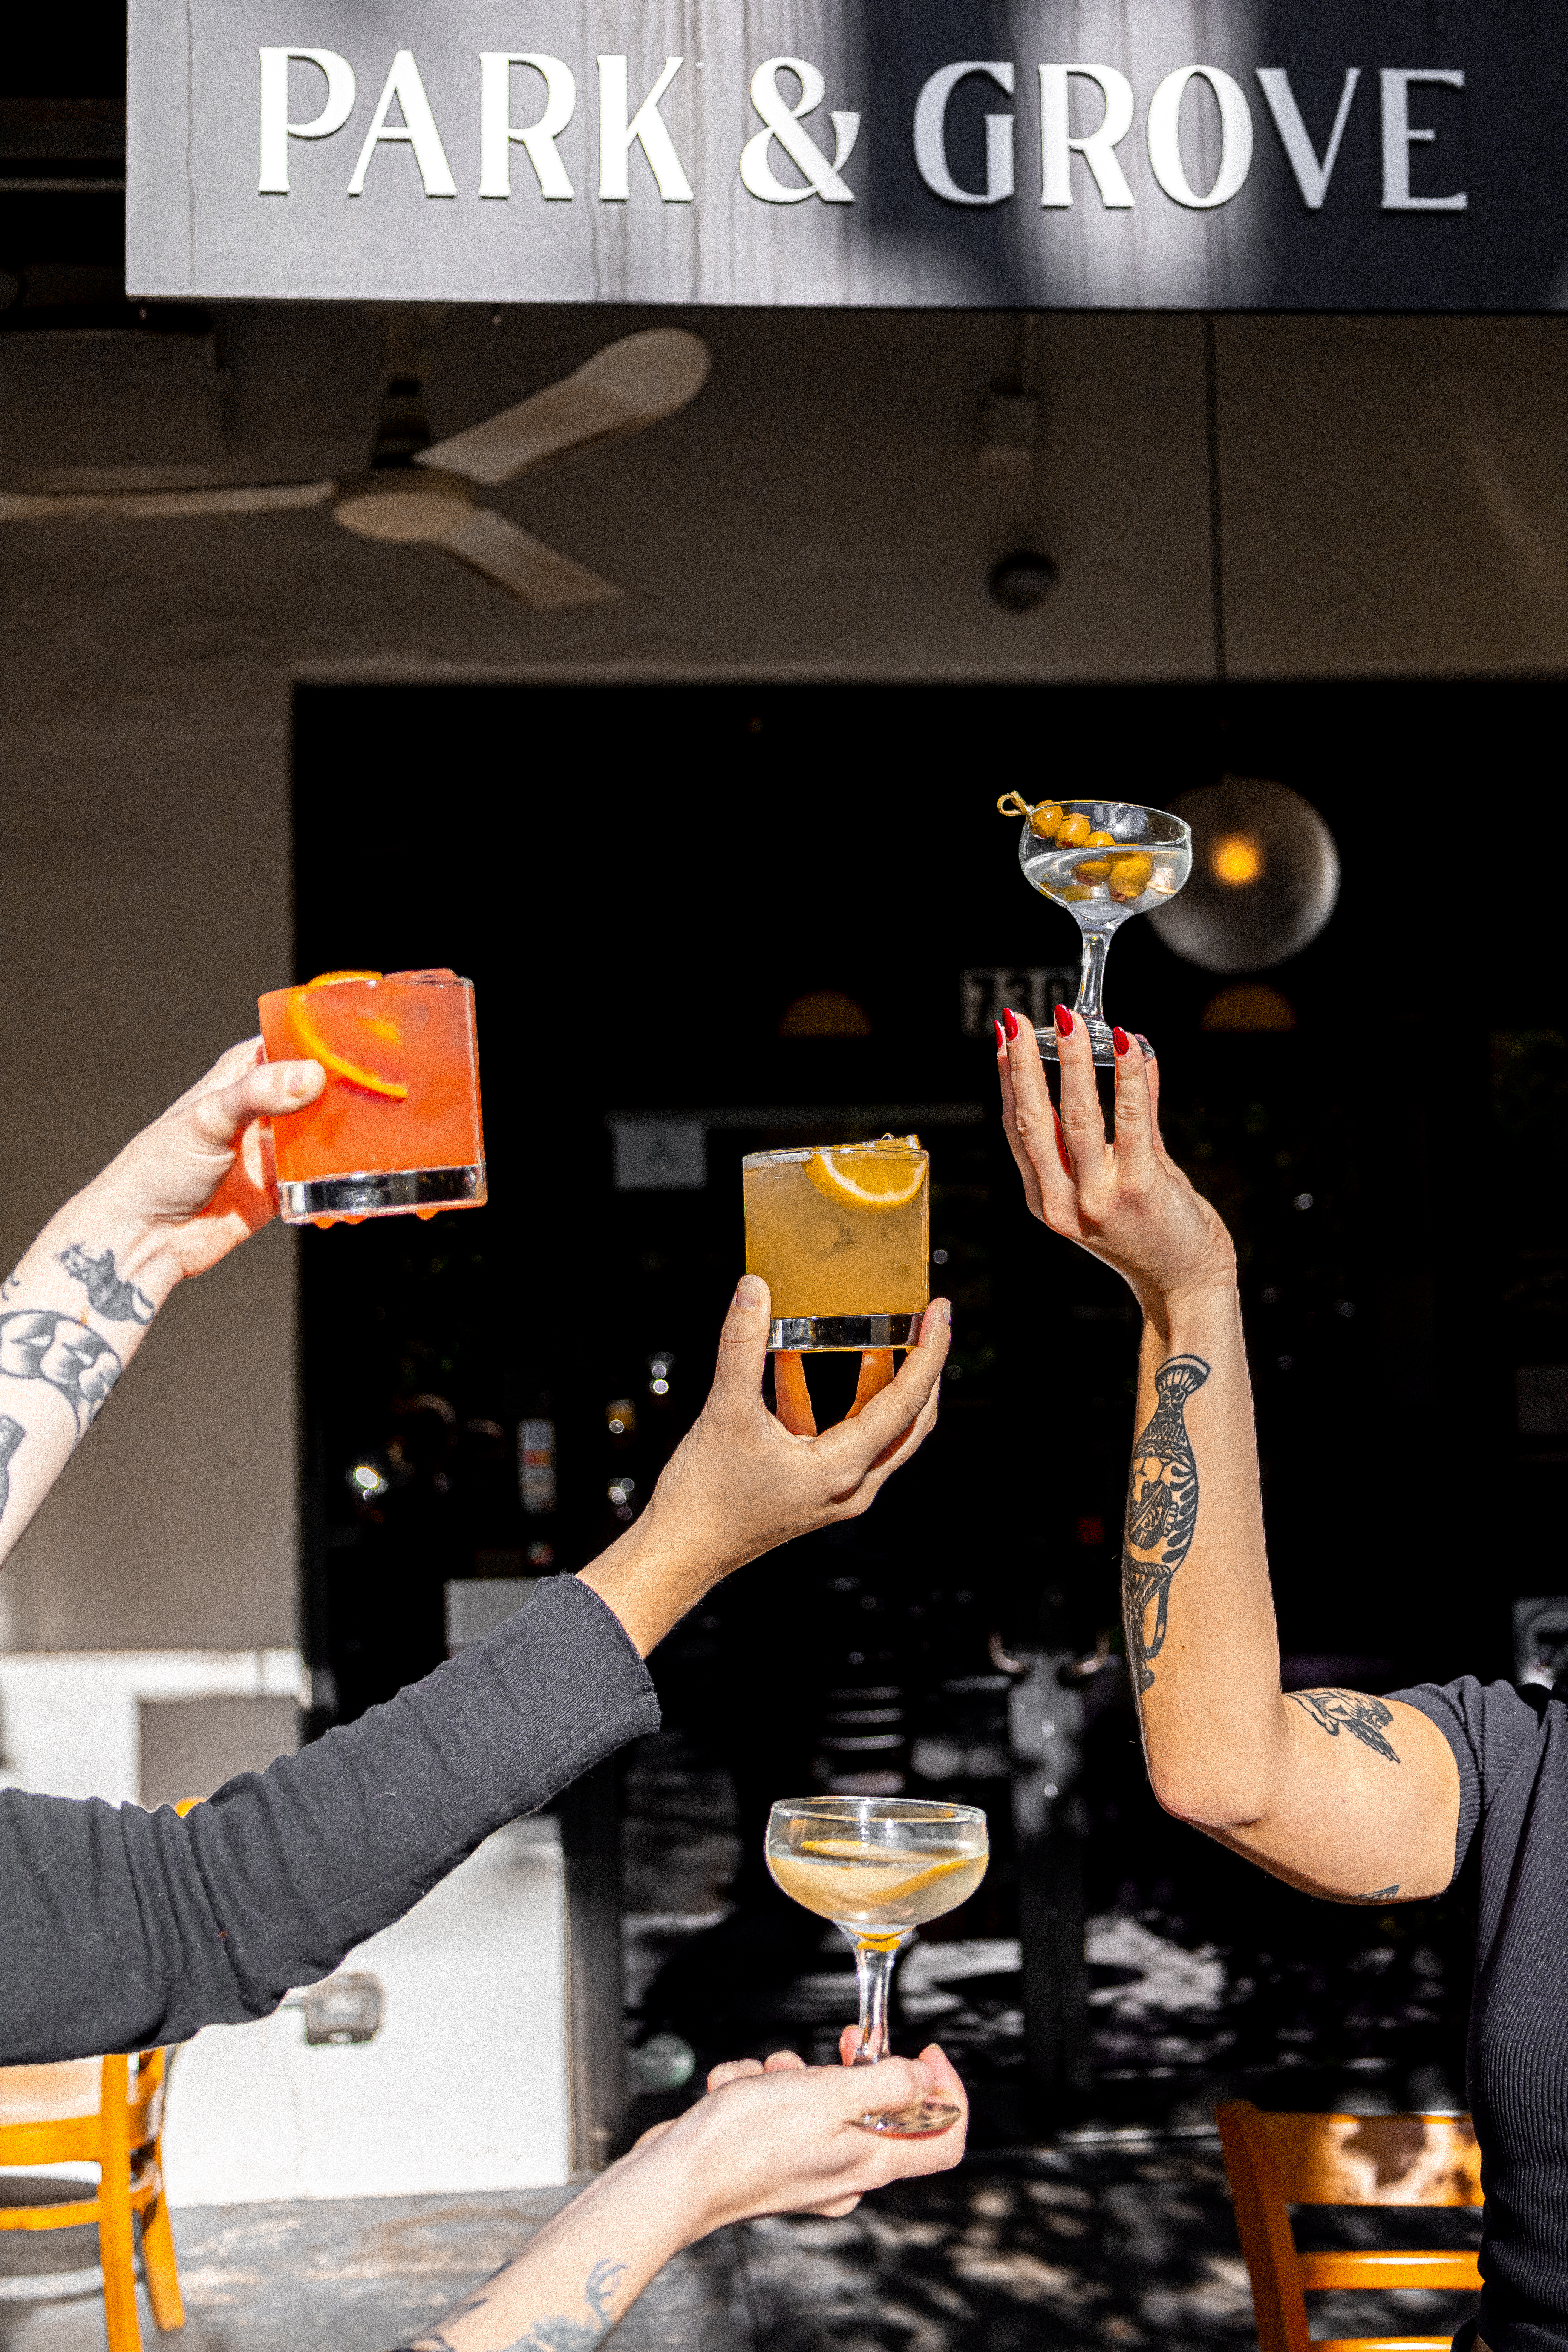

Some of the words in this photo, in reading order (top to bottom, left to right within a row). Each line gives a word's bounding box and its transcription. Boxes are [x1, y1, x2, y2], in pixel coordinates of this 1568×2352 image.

[258, 46, 695, 202] PARK
[740, 56, 861, 203] &
[913, 60, 1468, 210] GROVE
